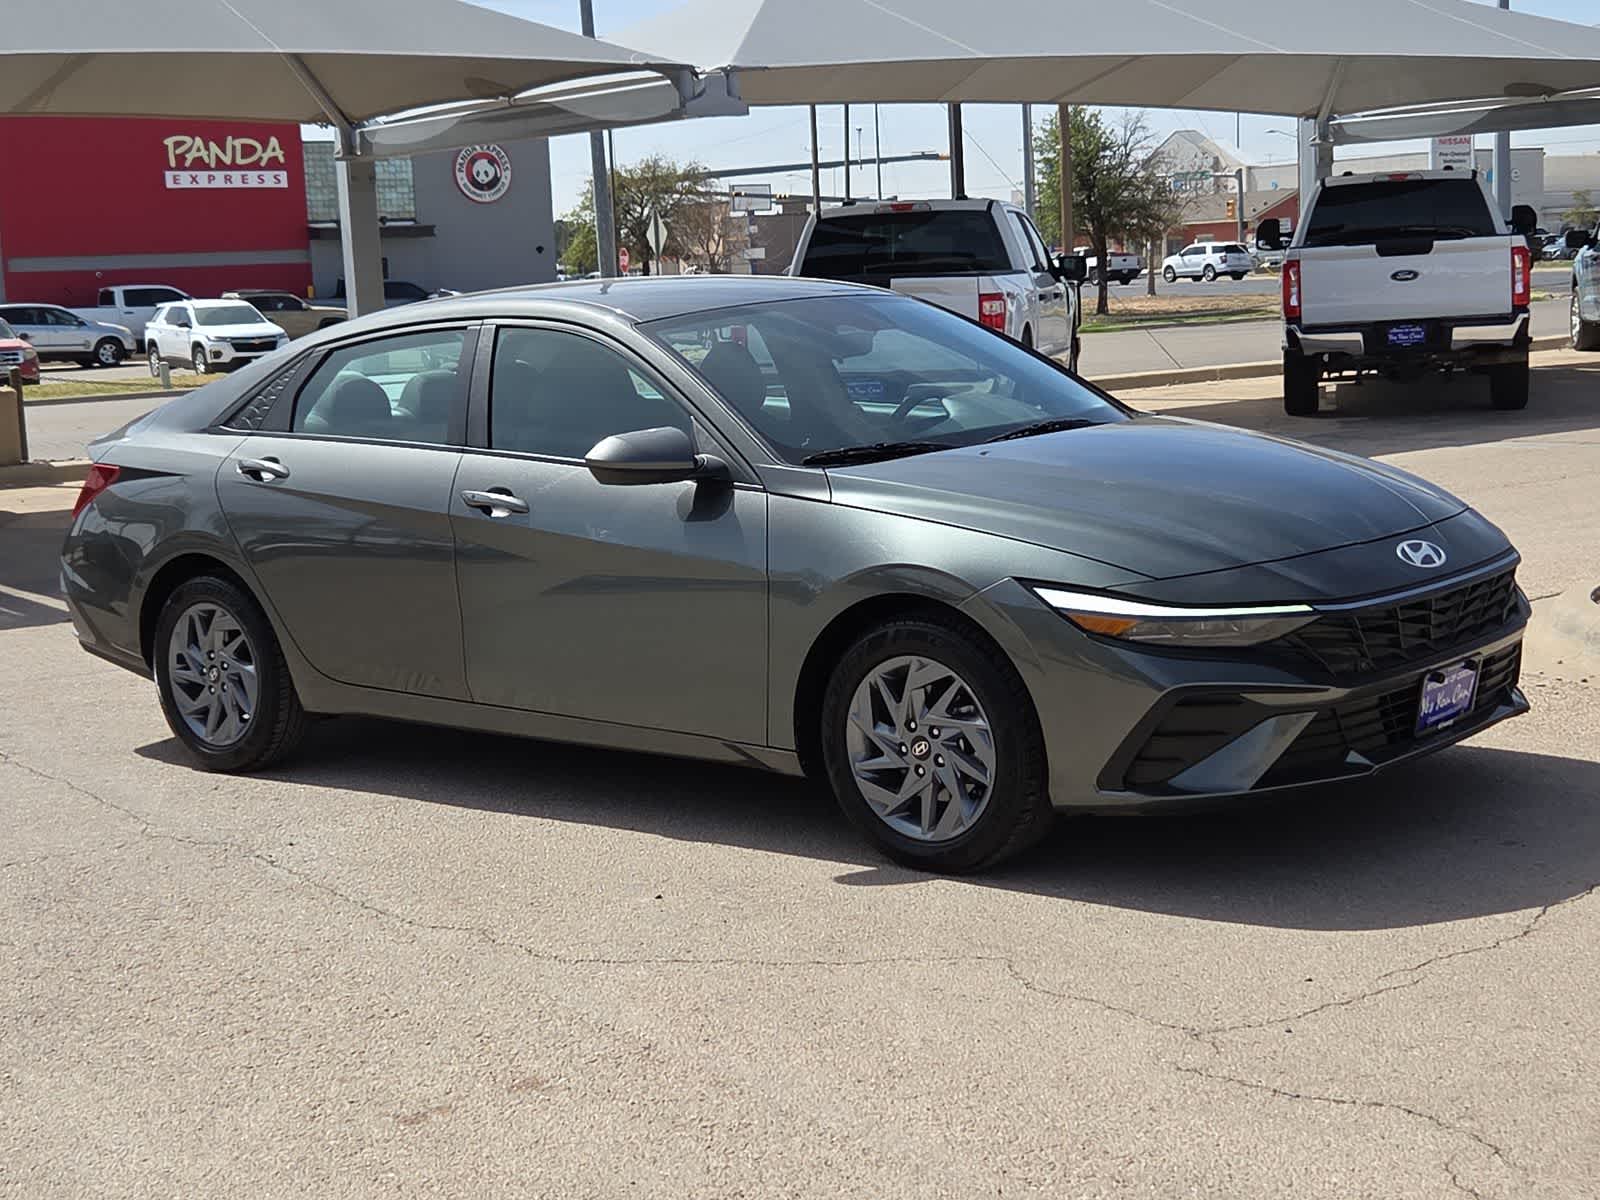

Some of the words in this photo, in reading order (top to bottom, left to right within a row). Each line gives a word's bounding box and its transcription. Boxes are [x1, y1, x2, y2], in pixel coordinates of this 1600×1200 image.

[1438, 136, 1471, 145] NISSAN
[163, 135, 285, 168] PANDA
[458, 145, 478, 173] PANDA
[171, 173, 283, 186] EXPRESS
